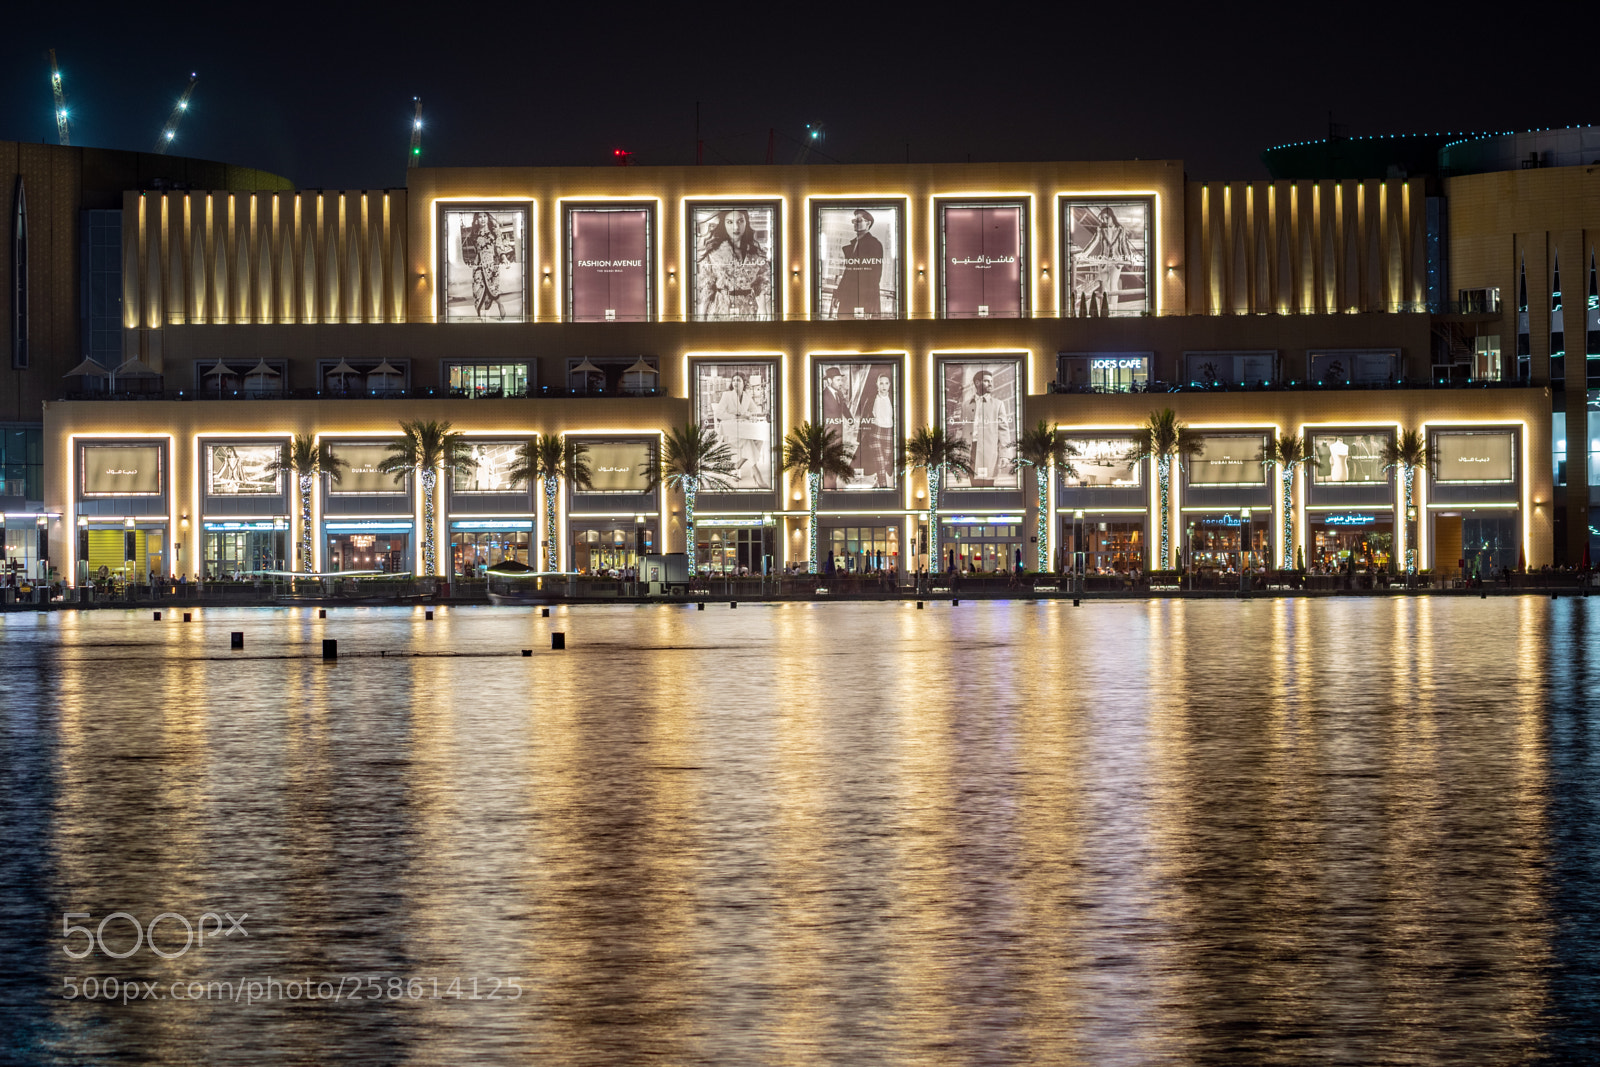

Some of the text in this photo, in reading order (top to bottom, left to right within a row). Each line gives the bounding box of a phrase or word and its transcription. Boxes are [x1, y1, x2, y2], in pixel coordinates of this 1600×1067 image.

[577, 259, 642, 267] FASHION AVENUE
[1093, 359, 1142, 369] JOE'S CAFE
